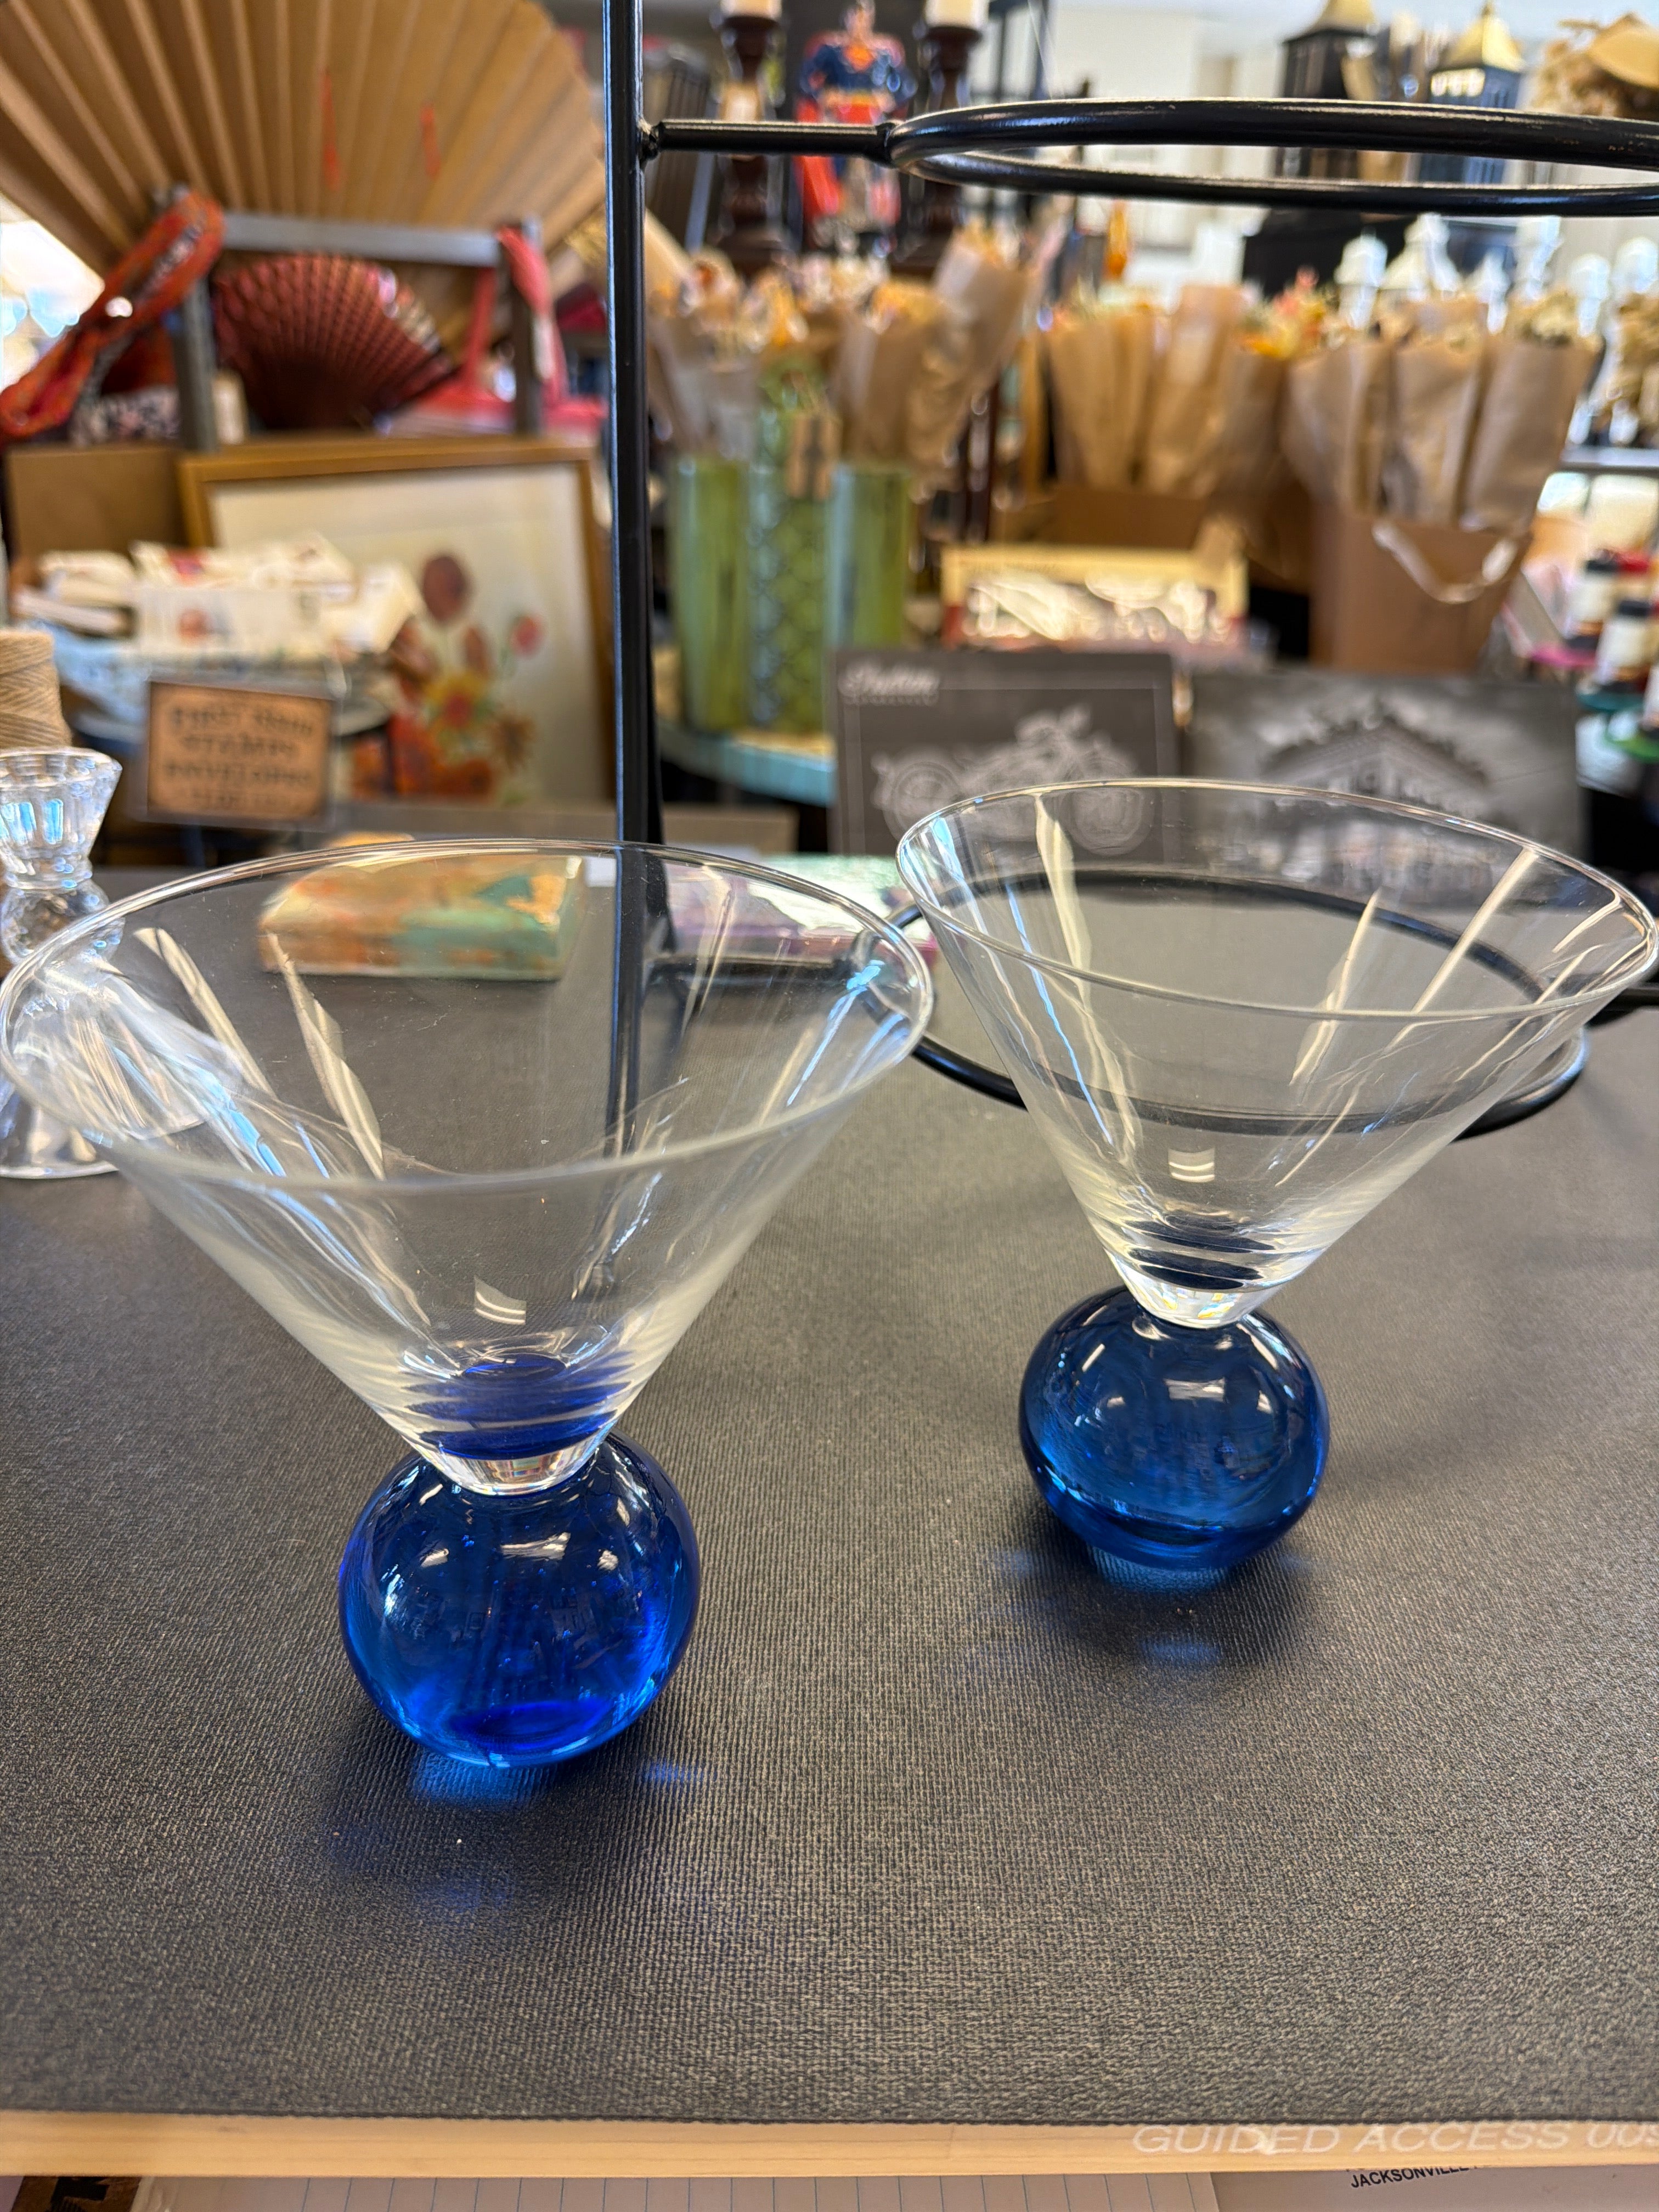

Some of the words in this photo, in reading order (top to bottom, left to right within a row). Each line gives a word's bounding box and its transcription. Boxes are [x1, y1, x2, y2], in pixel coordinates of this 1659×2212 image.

[1133, 2124, 1340, 2154] GUIDED
[1351, 2121, 1572, 2152] ACCESS
[1351, 2166, 1470, 2188] JACKSONVI
